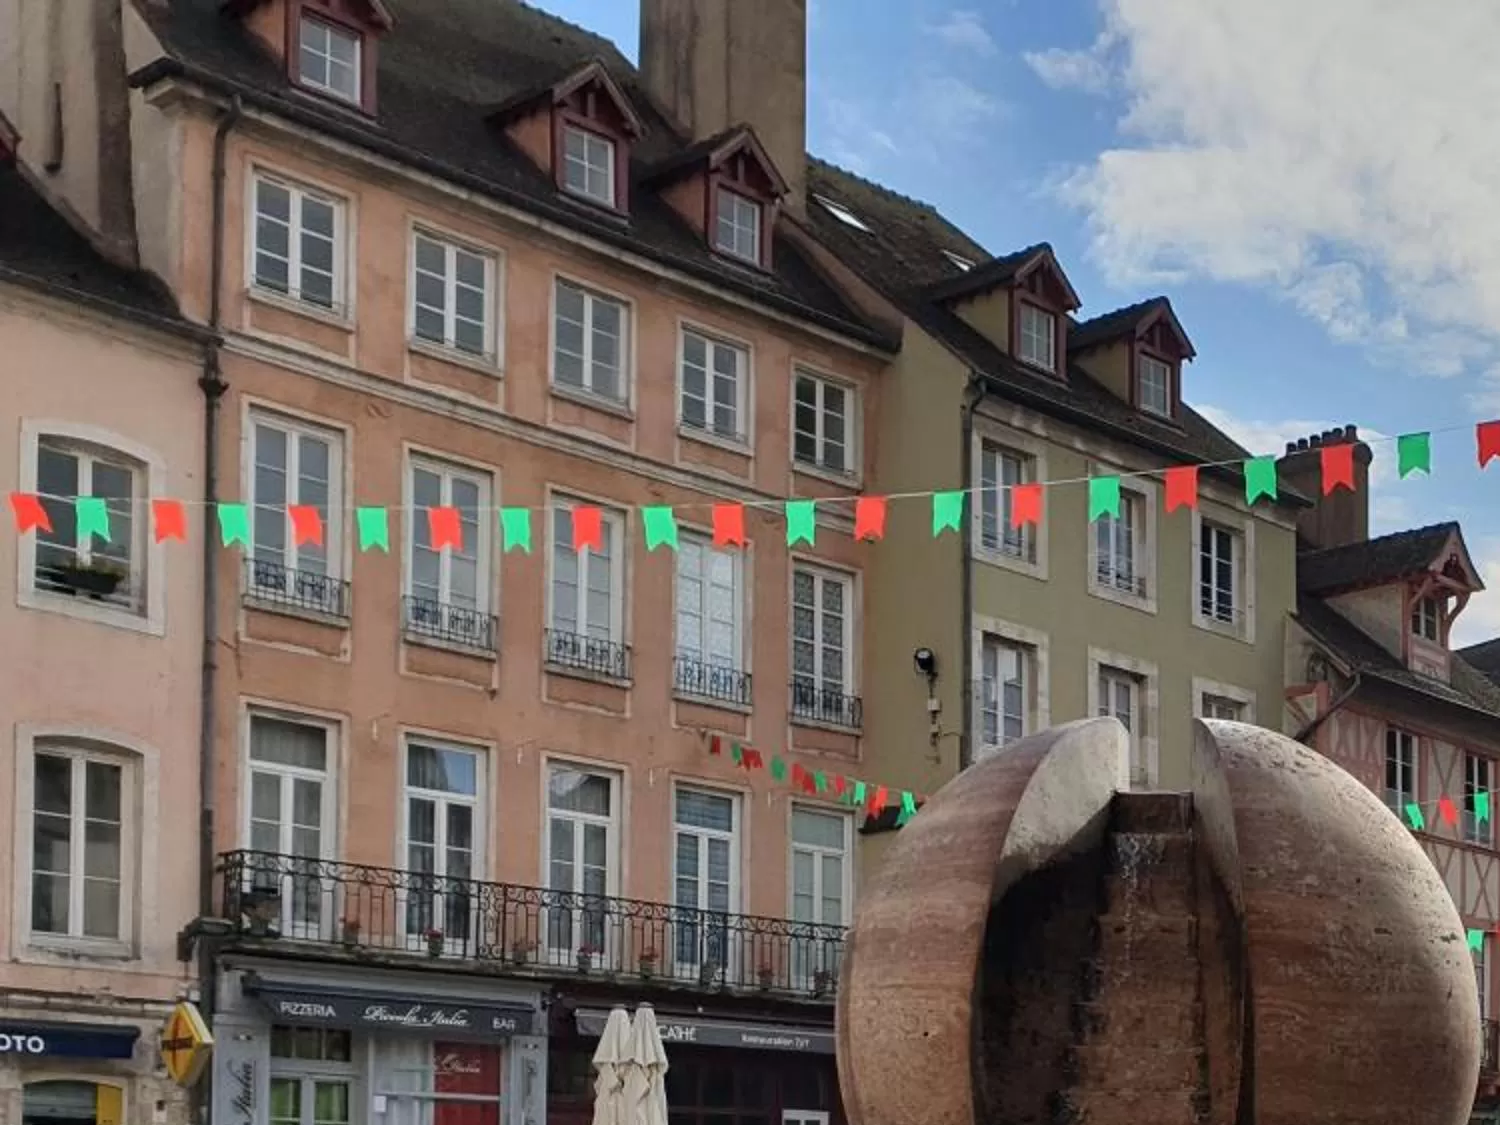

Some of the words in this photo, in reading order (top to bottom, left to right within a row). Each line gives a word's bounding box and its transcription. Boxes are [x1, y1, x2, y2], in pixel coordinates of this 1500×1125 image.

[279, 1001, 337, 1017] PIZZERIA
[424, 1009, 472, 1026] Italia
[492, 1017, 517, 1031] BAR
